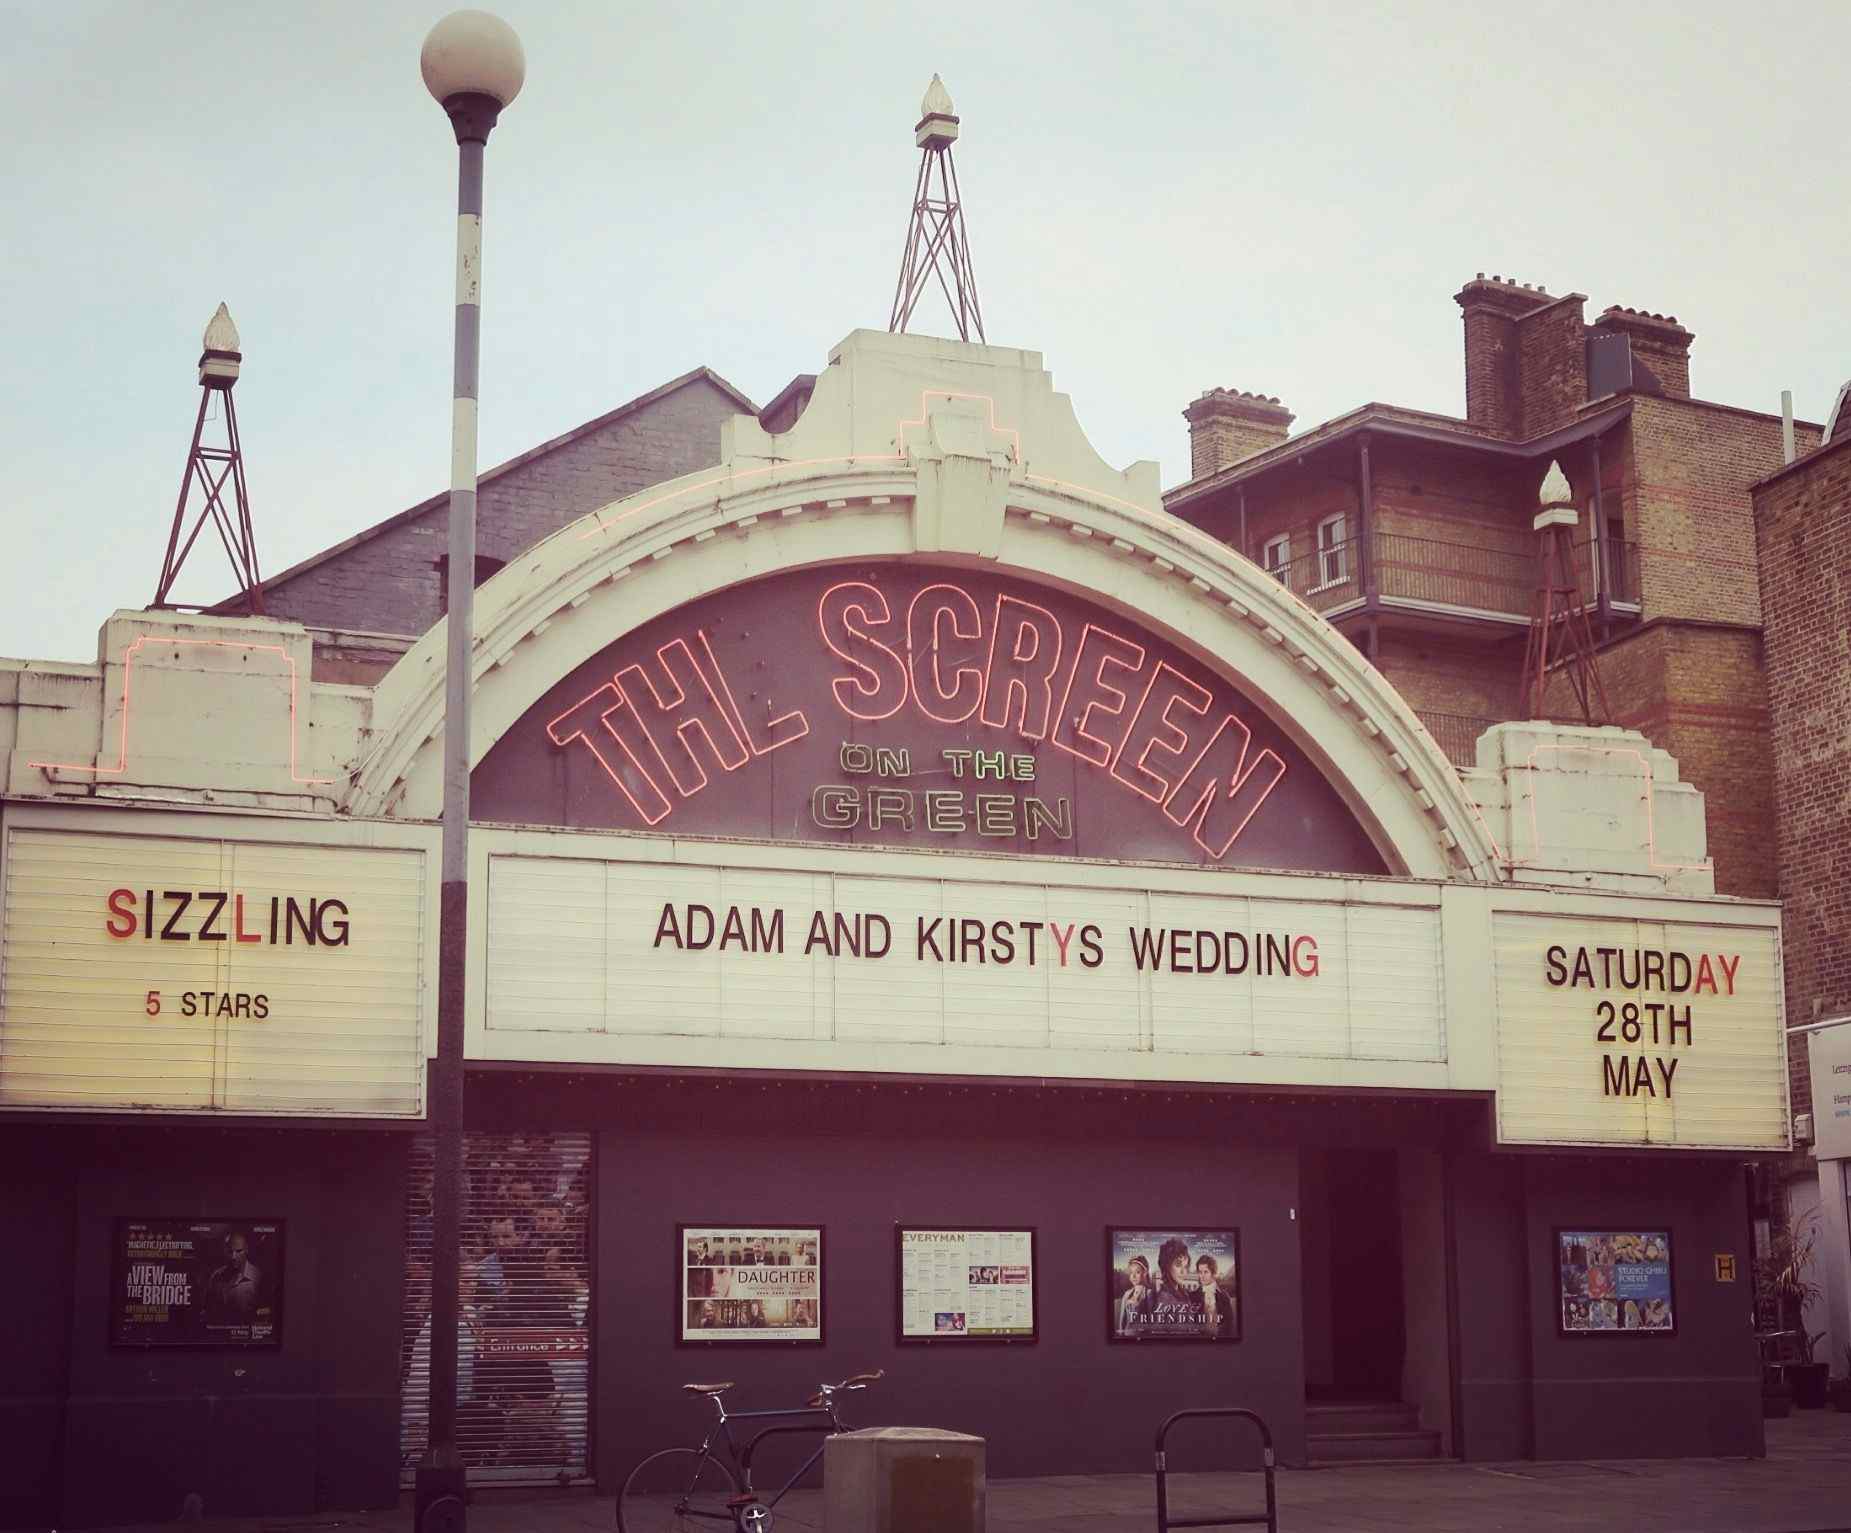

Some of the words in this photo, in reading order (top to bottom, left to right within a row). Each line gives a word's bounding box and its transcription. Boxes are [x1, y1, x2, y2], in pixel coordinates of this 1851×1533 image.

[819, 582, 1287, 859] SCREEN
[840, 742, 911, 777] ON
[942, 750, 1036, 780] THE
[812, 785, 1072, 840] GREEN
[106, 888, 349, 946] SIZZLING
[653, 902, 784, 953] ADAM
[804, 910, 892, 958] AND
[917, 916, 1104, 968] KIRSTYS
[1129, 926, 1320, 977] WEDDING
[1546, 945, 1740, 995] SATURDAY
[145, 990, 161, 1016] 5
[181, 991, 270, 1019] STARS
[1596, 1001, 1692, 1046] 28TH
[1603, 1055, 1679, 1099] MAY
[903, 1233, 965, 1242] EVERYMAN
[127, 1273, 133, 1285] A
[132, 1265, 165, 1285] VIEW
[164, 1273, 187, 1285] FROM
[738, 1271, 816, 1284] DAUGHTER
[1717, 1257, 1734, 1279] H
[127, 1286, 143, 1298] THE
[143, 1286, 192, 1305] BRIDGE
[1128, 1311, 1224, 1323] FRIENDSHIP
